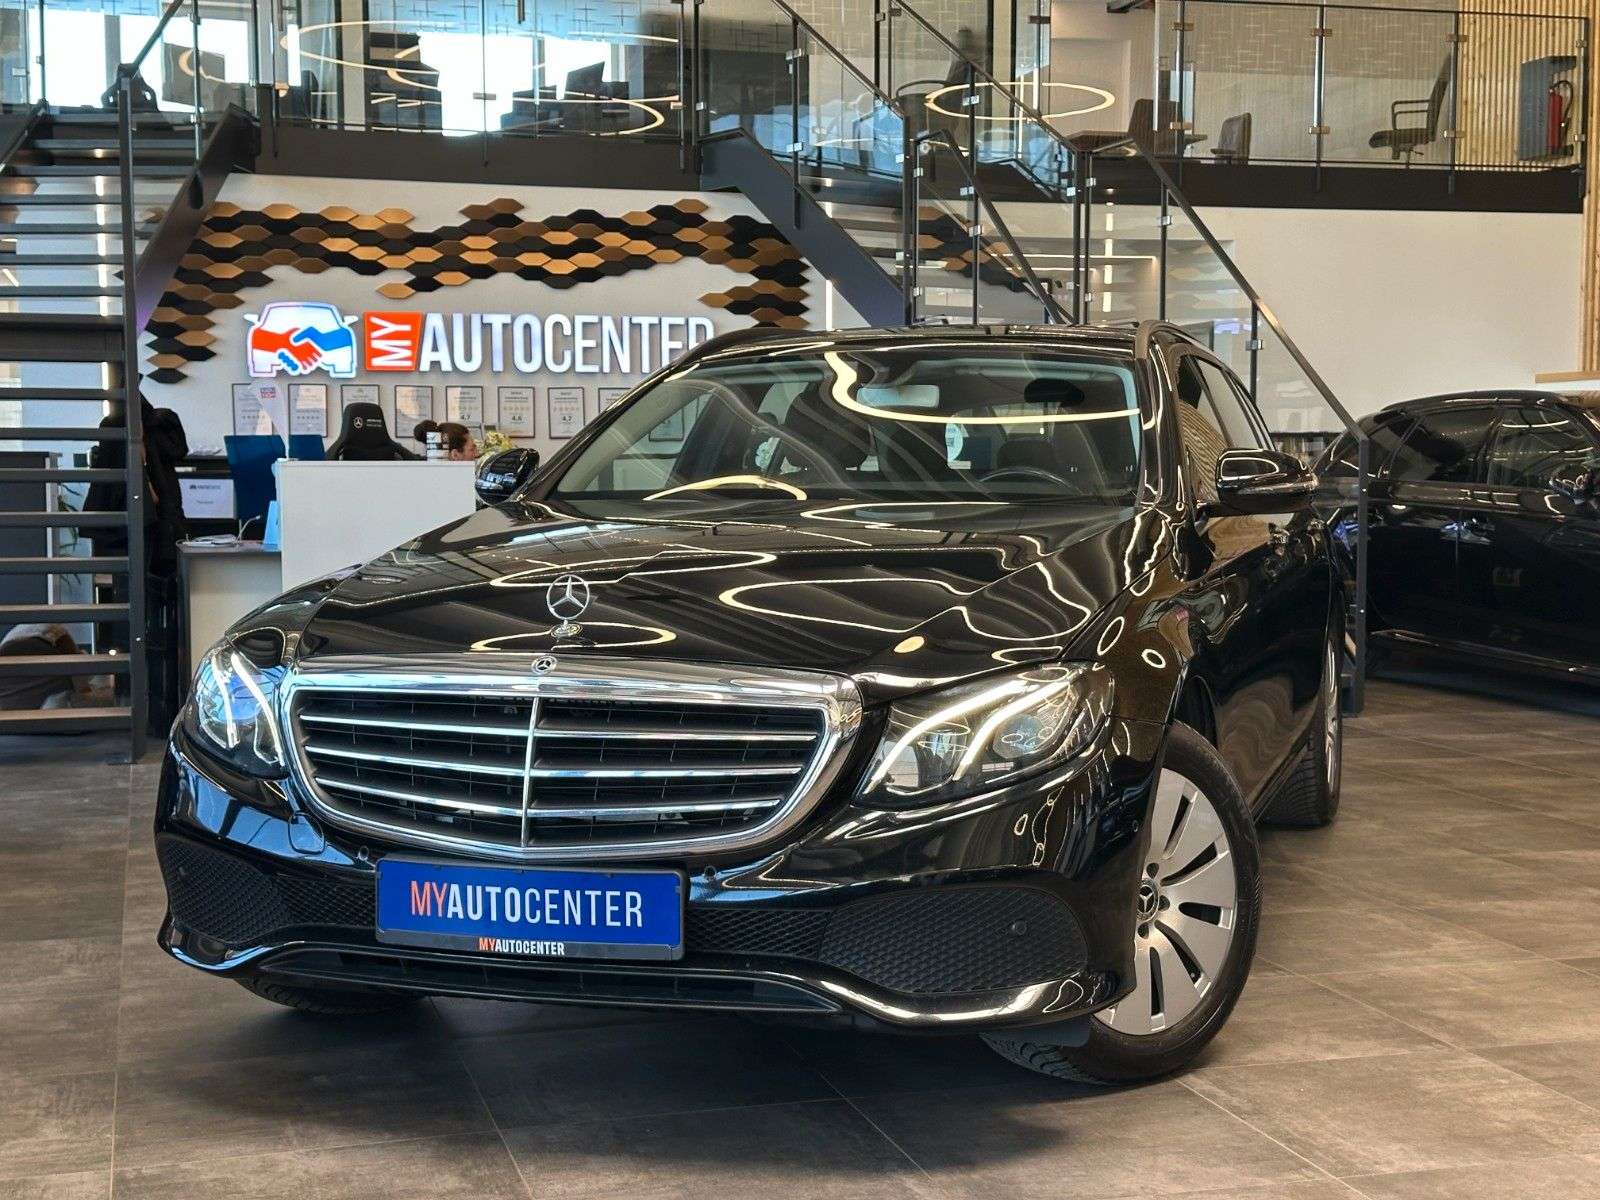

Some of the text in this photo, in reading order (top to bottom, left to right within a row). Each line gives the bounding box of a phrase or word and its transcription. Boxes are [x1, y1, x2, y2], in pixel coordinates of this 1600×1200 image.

[369, 316, 413, 367] MY
[410, 880, 643, 928] MYAUTOCENTER
[478, 937, 565, 956] MYAUTOCENTER
